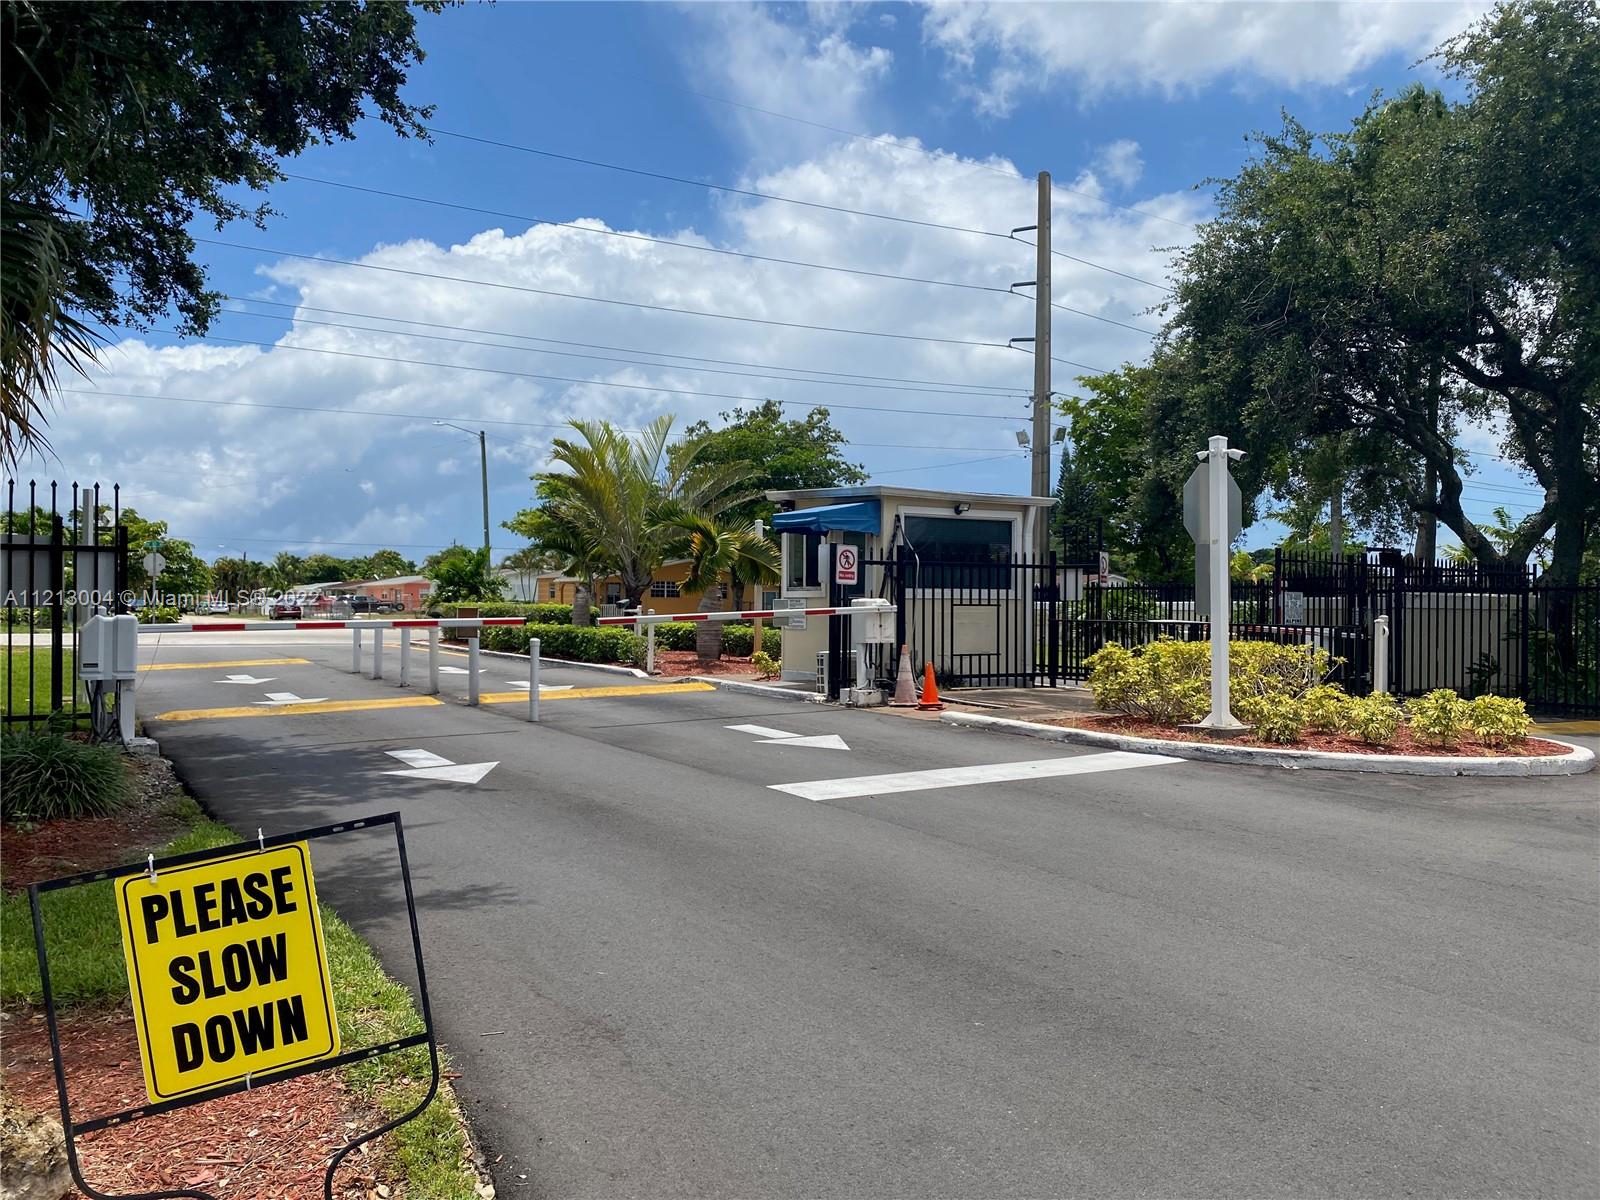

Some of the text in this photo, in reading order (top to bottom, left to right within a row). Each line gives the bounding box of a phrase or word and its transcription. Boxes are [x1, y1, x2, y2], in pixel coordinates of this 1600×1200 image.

[140, 865, 298, 945] PLEASE
[168, 932, 288, 1006] SLOW
[171, 994, 309, 1074] DOWN
